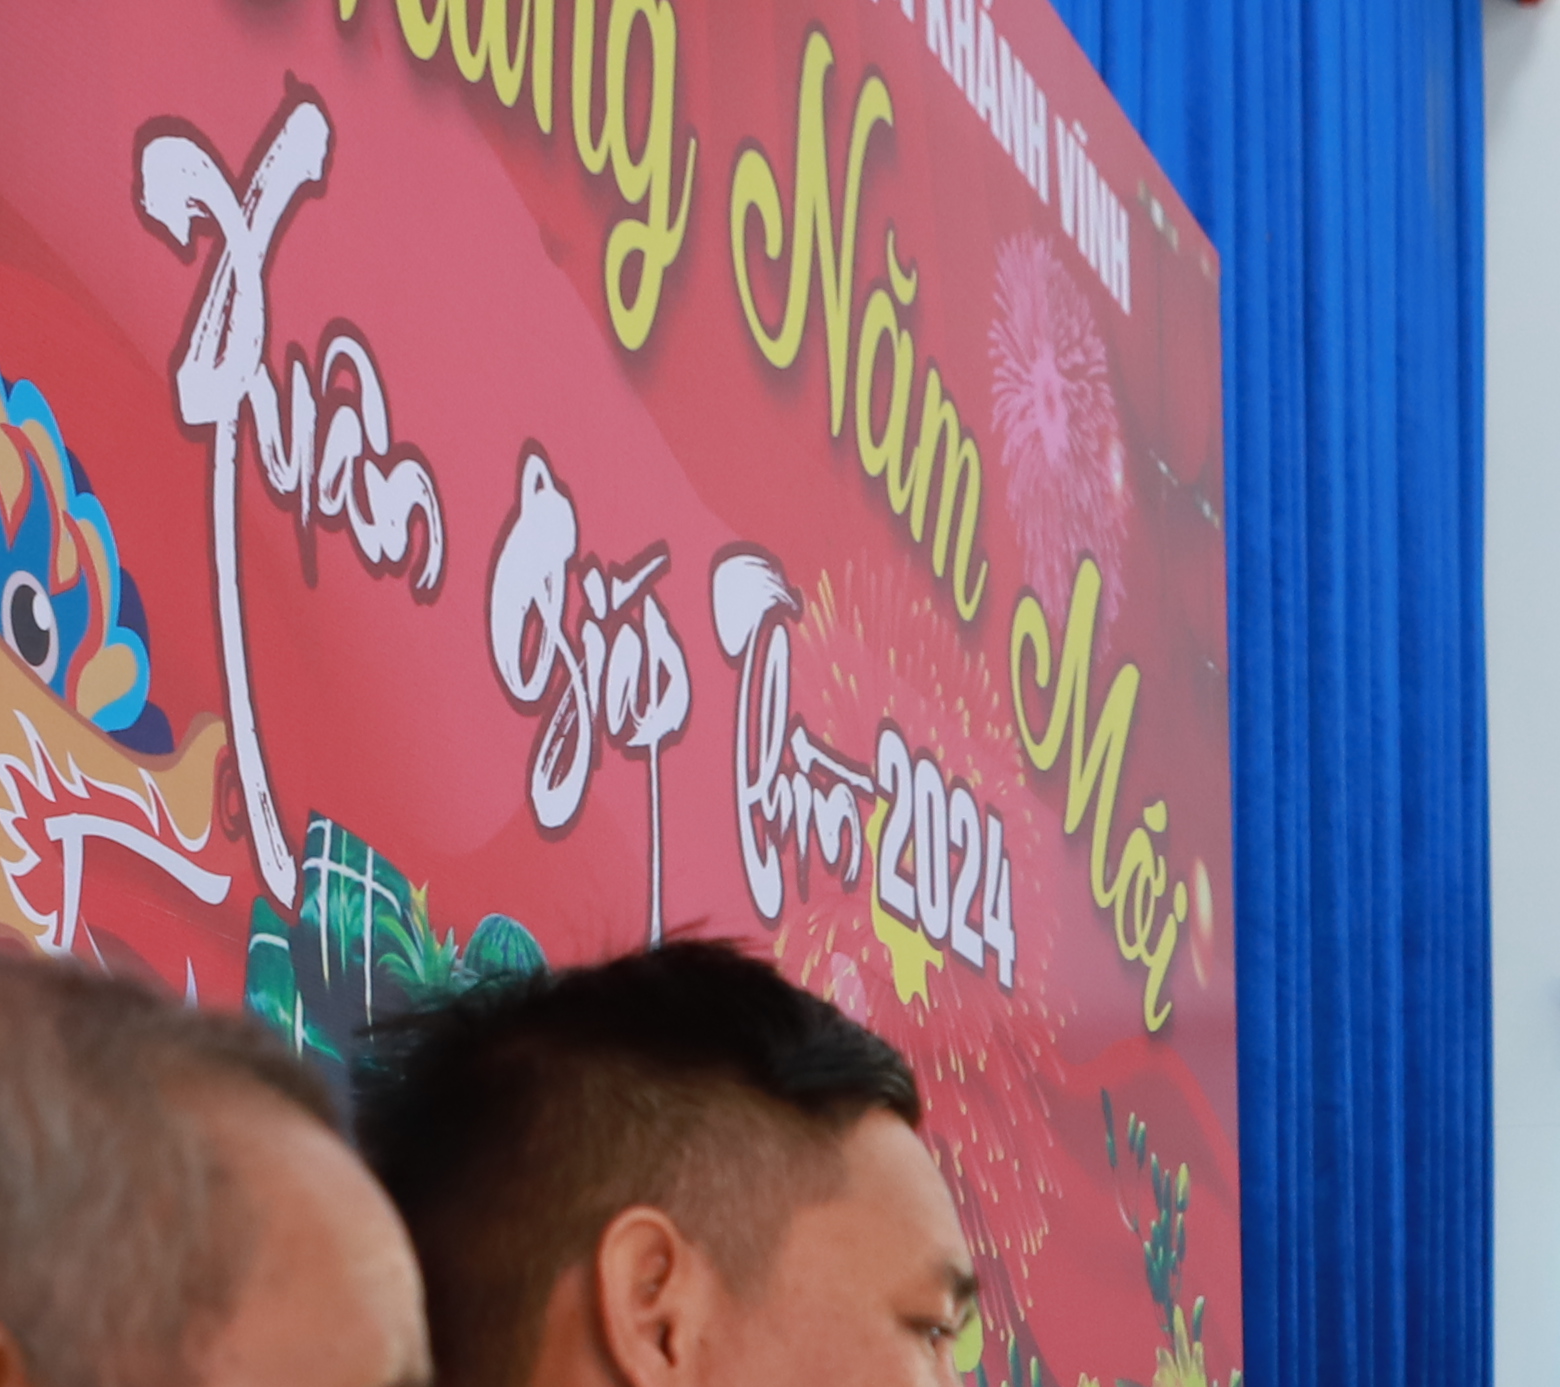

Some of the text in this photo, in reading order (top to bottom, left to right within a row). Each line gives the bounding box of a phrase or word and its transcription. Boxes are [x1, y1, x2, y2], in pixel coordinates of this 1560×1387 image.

[141, 100, 443, 909] Xuân
[491, 454, 690, 948] Giáp
[876, 729, 1016, 989] 2024
[731, 31, 988, 621] Năm
[1010, 557, 1188, 1032] Mới
[1054, 112, 1131, 317] VĨNH
